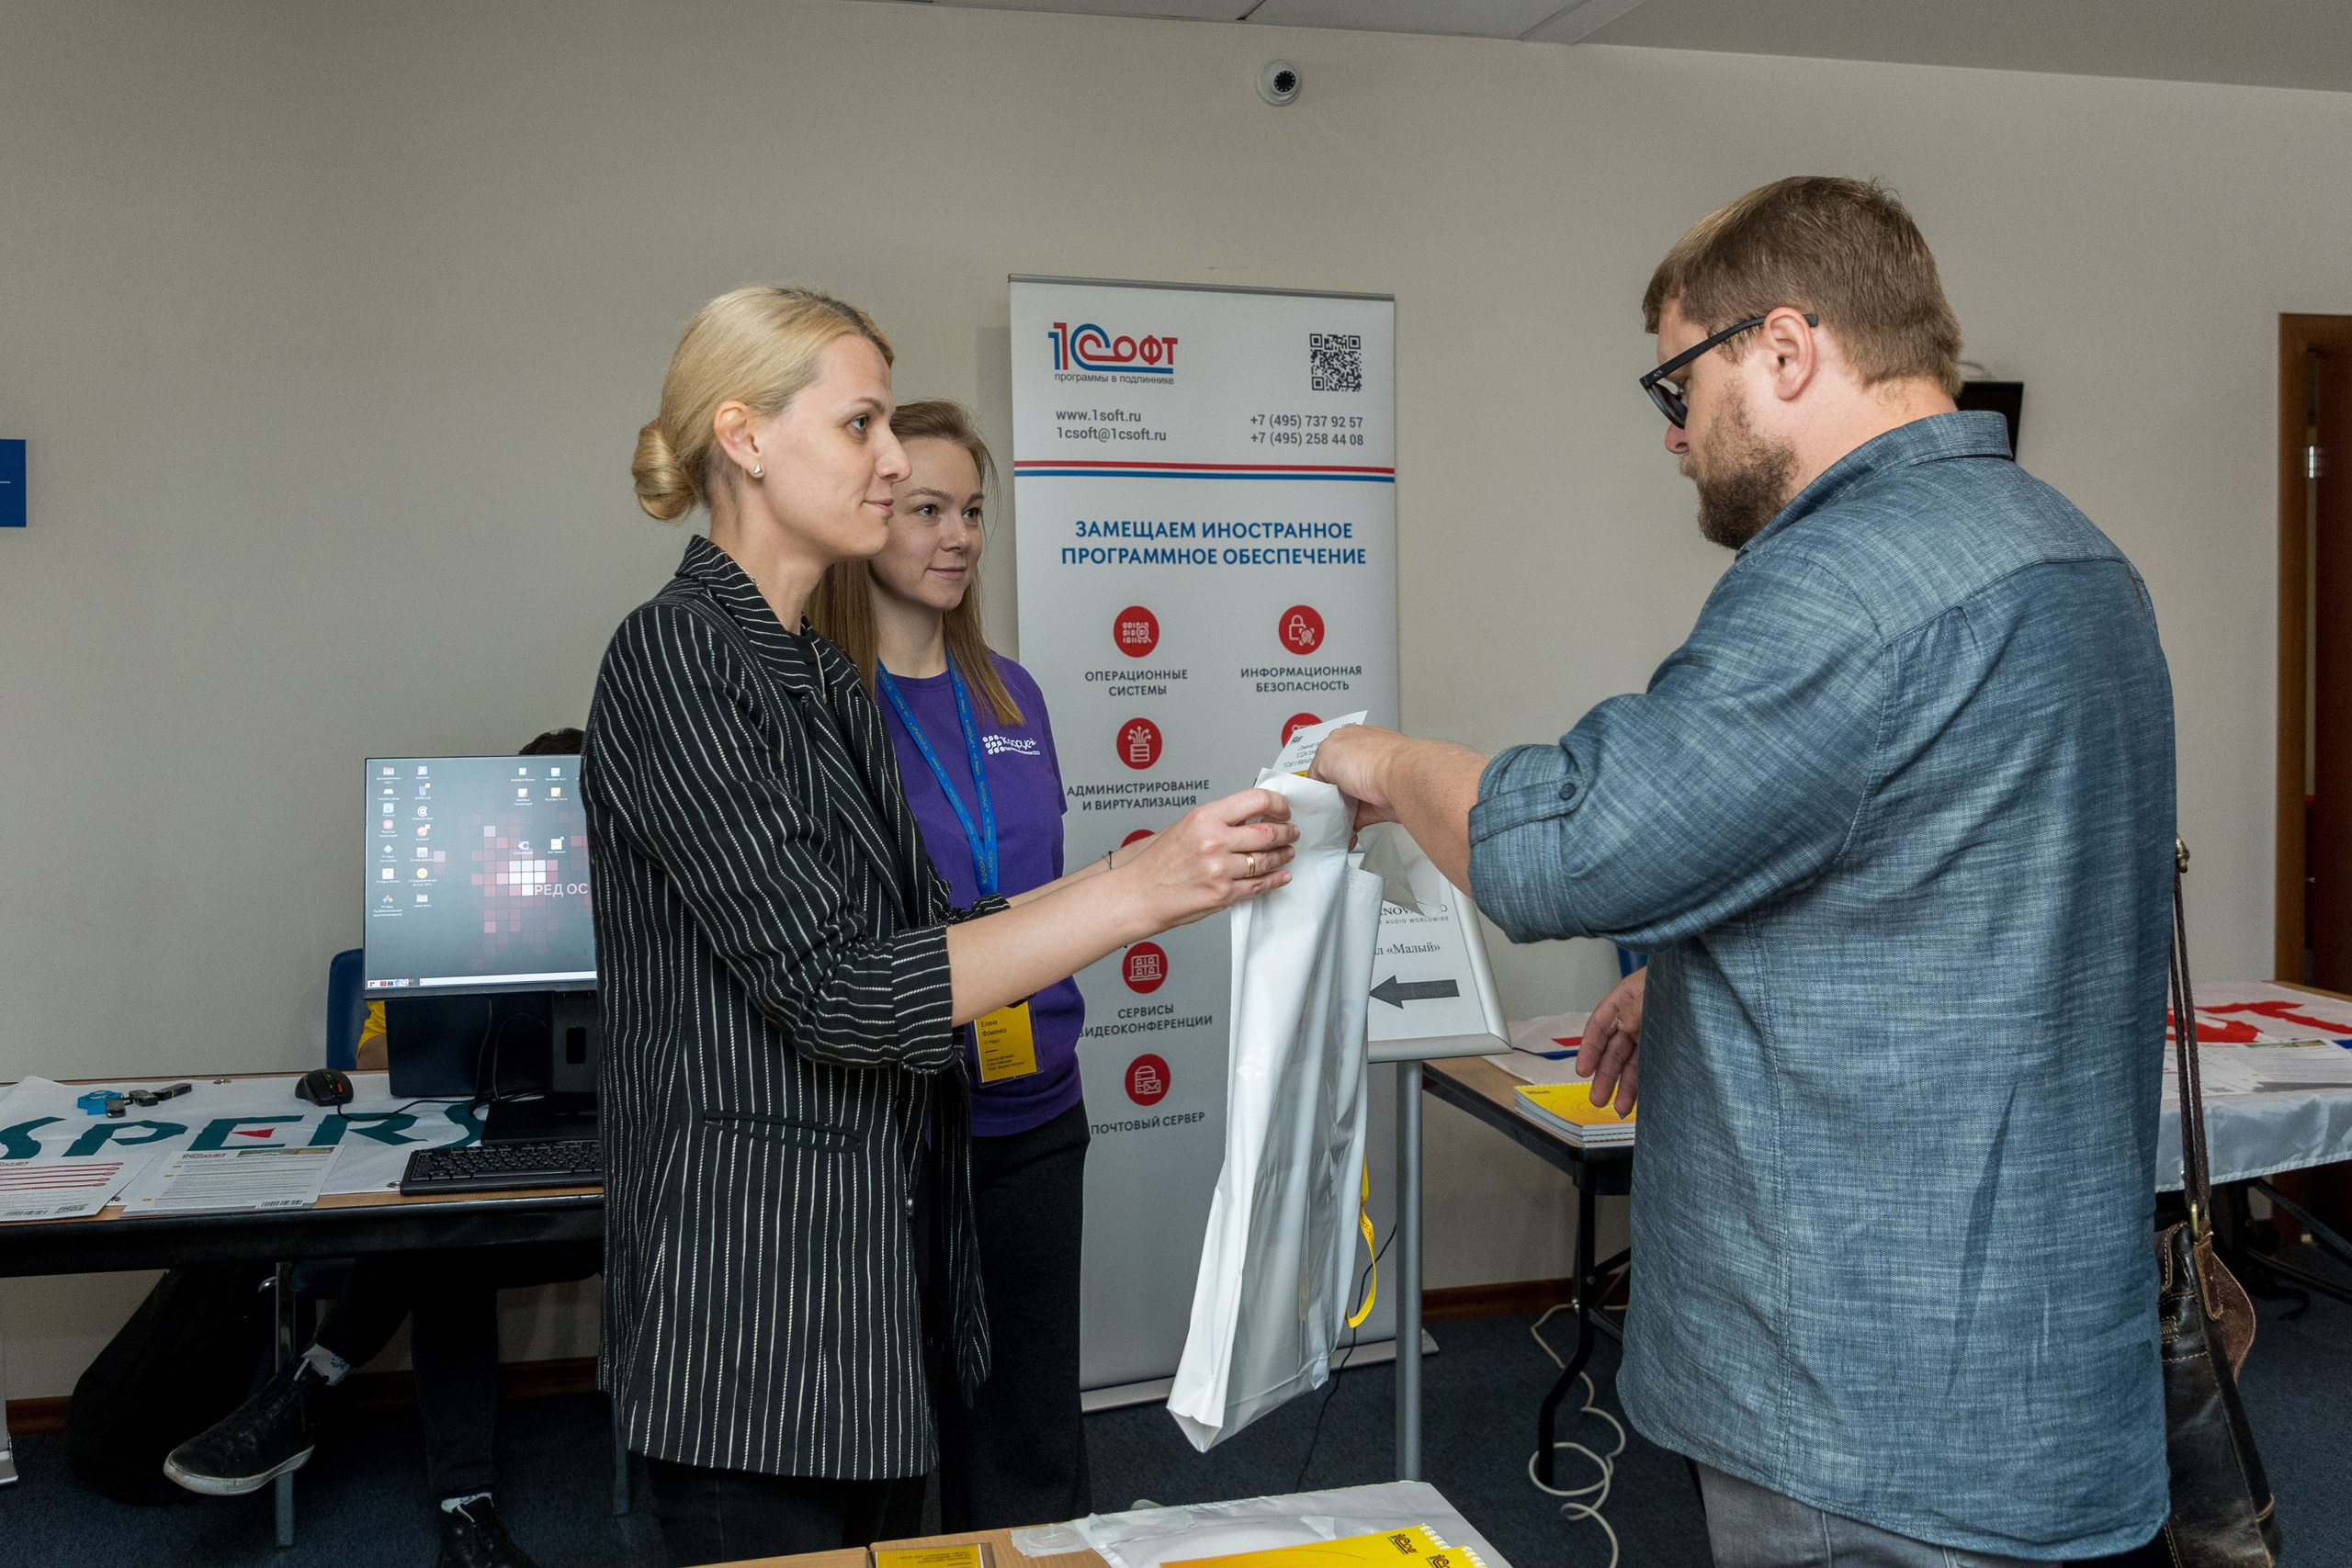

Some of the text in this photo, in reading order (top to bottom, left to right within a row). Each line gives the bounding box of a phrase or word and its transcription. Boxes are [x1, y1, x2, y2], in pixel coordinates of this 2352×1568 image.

[1054, 372, 1109, 383] программы
[1120, 375, 1174, 385] подлиннике
[1056, 409, 1141, 422] www.1soft.ru
[1250, 414, 1363, 429] +7 (495) 737 92 57
[1057, 426, 1167, 442] 1csoft@1csoft.ru
[1250, 432, 1364, 446] +7 (495) 258 44 08
[1075, 521, 1353, 540] ЗАМЕЩАЕМ ИНОСТРАННОЕ
[1061, 547, 1366, 565] ПРОГРАММНОЕ ОБЕСПЕЧЕНИЕ
[1085, 669, 1188, 682] ОПЕРАЦИОННЫЕ
[1240, 665, 1363, 679] ИНФОРМАЦИОННАЯ
[1109, 685, 1167, 696] СИСТЕМЫ
[1256, 681, 1350, 693] БЕЗОПАСНОСТЬ
[1067, 780, 1210, 798] АДМИНИСТРИРОВАНИЕ
[1082, 795, 1197, 811] И ВИРТУАЛИЗАЦИЯ
[535, 883, 588, 898] РЕД ОС
[1386, 942, 1441, 954] «Малый»
[1117, 1004, 1174, 1019] СЕРВИСЫ
[981, 1020, 998, 1028] Елена
[1091, 1111, 1205, 1135] ПОЧТОВЫЙ СЕРВЕР
